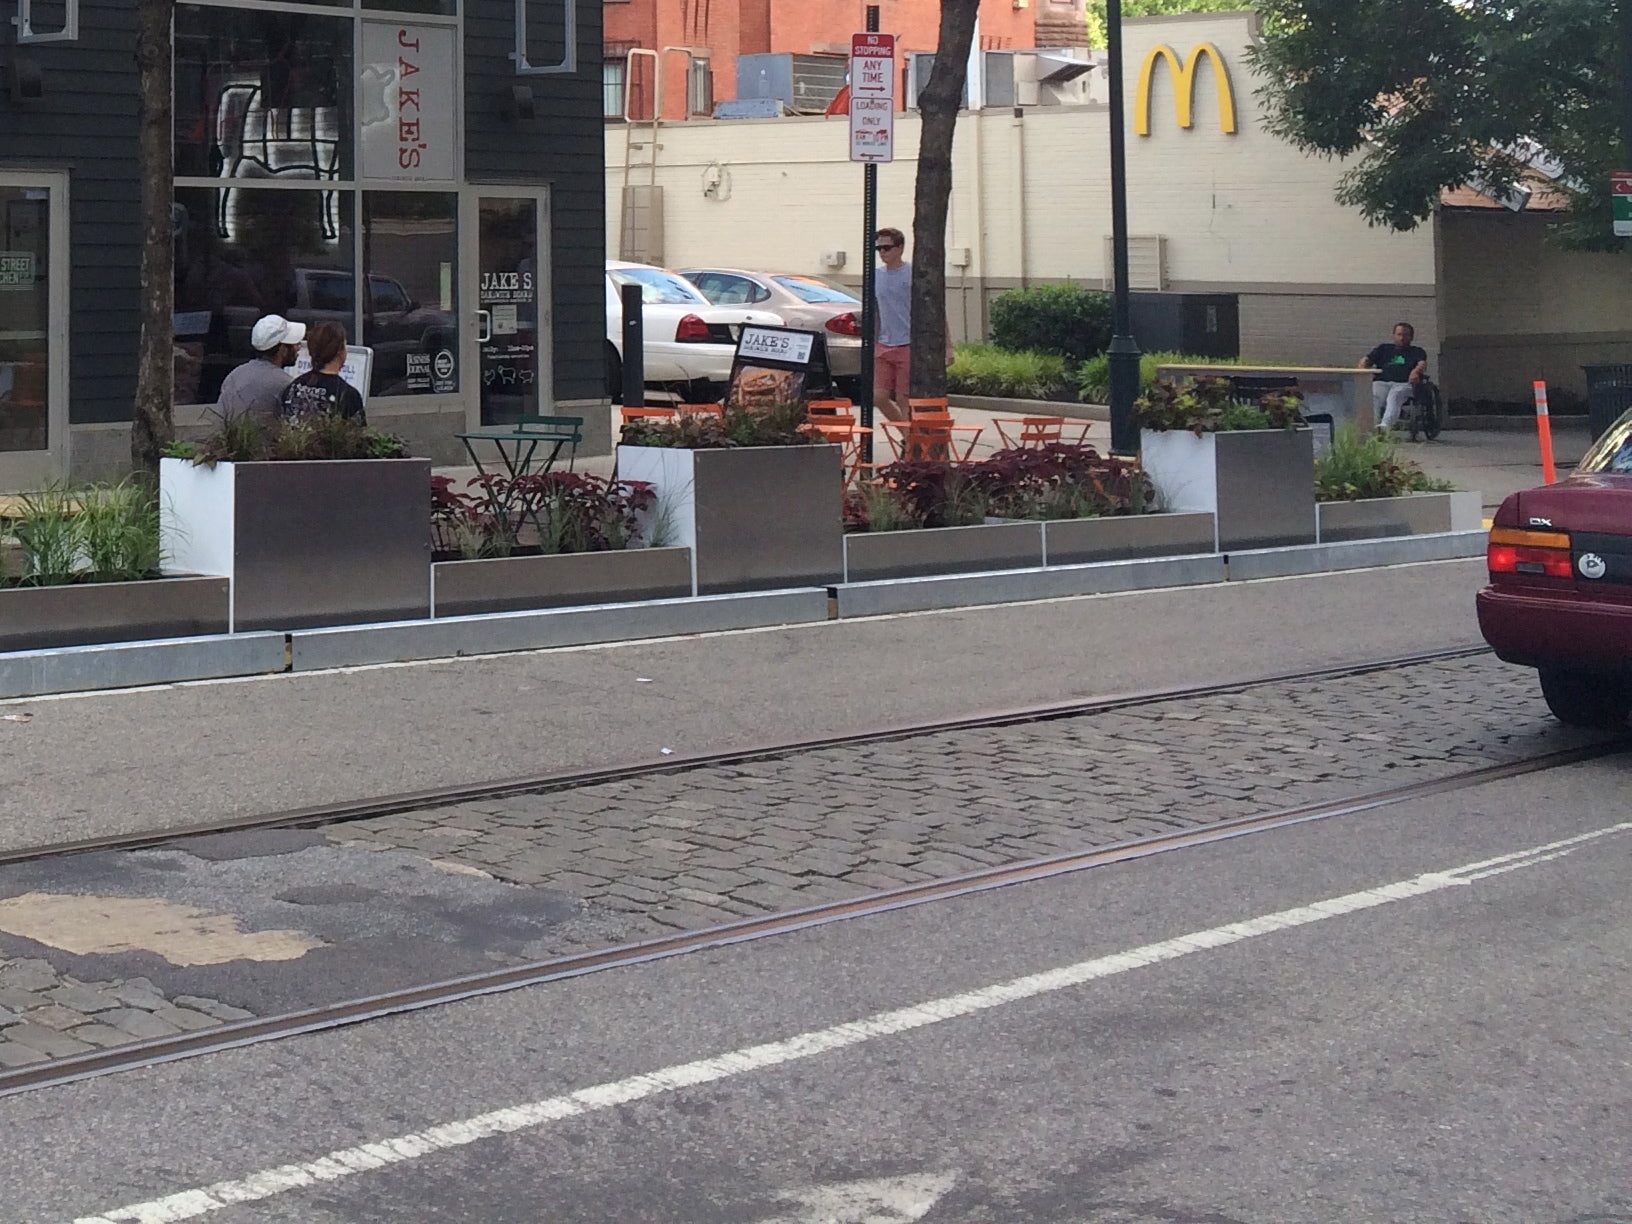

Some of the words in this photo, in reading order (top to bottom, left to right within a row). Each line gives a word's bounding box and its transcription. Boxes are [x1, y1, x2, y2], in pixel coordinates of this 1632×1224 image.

[867, 36, 879, 45] NO
[854, 46, 891, 56] STOPPING
[862, 60, 883, 71] ANY
[862, 72, 884, 83] TIME
[398, 29, 428, 170] JAKE'S
[855, 101, 888, 111] LOADING
[0, 258, 31, 271] STREET
[481, 272, 533, 290] JAKES
[745, 333, 790, 349] JAKE'S
[1529, 517, 1552, 527] DX
